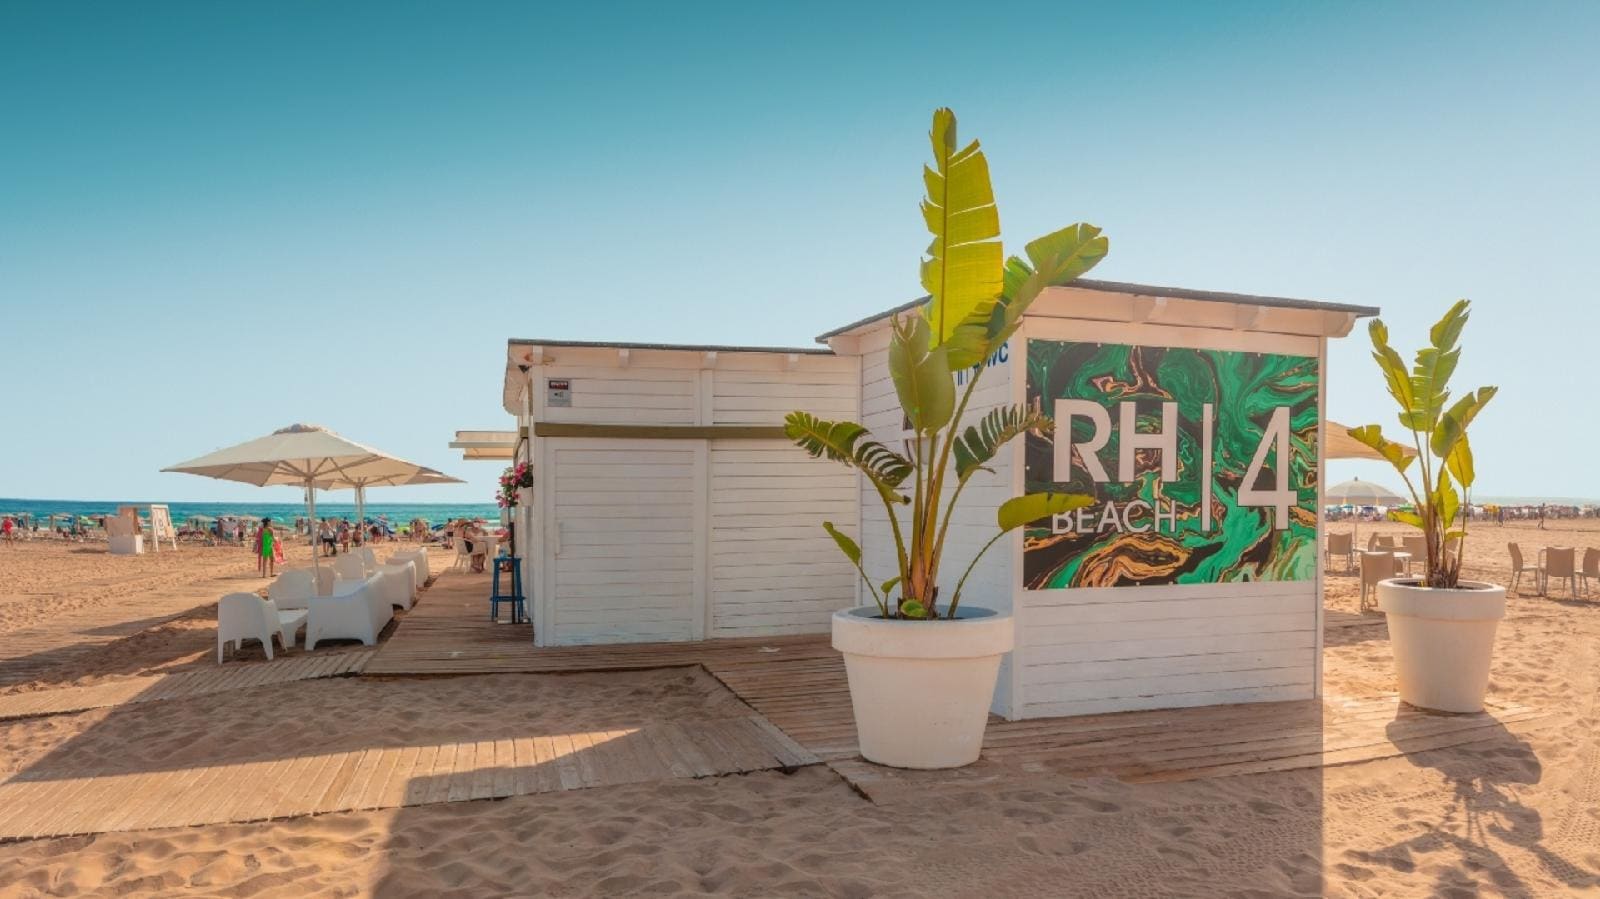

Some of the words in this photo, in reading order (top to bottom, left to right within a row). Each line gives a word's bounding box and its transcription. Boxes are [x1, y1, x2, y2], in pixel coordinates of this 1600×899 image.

[1053, 400, 1177, 482] RH
[1237, 406, 1297, 530] 4
[1052, 500, 1176, 534] BEACH
